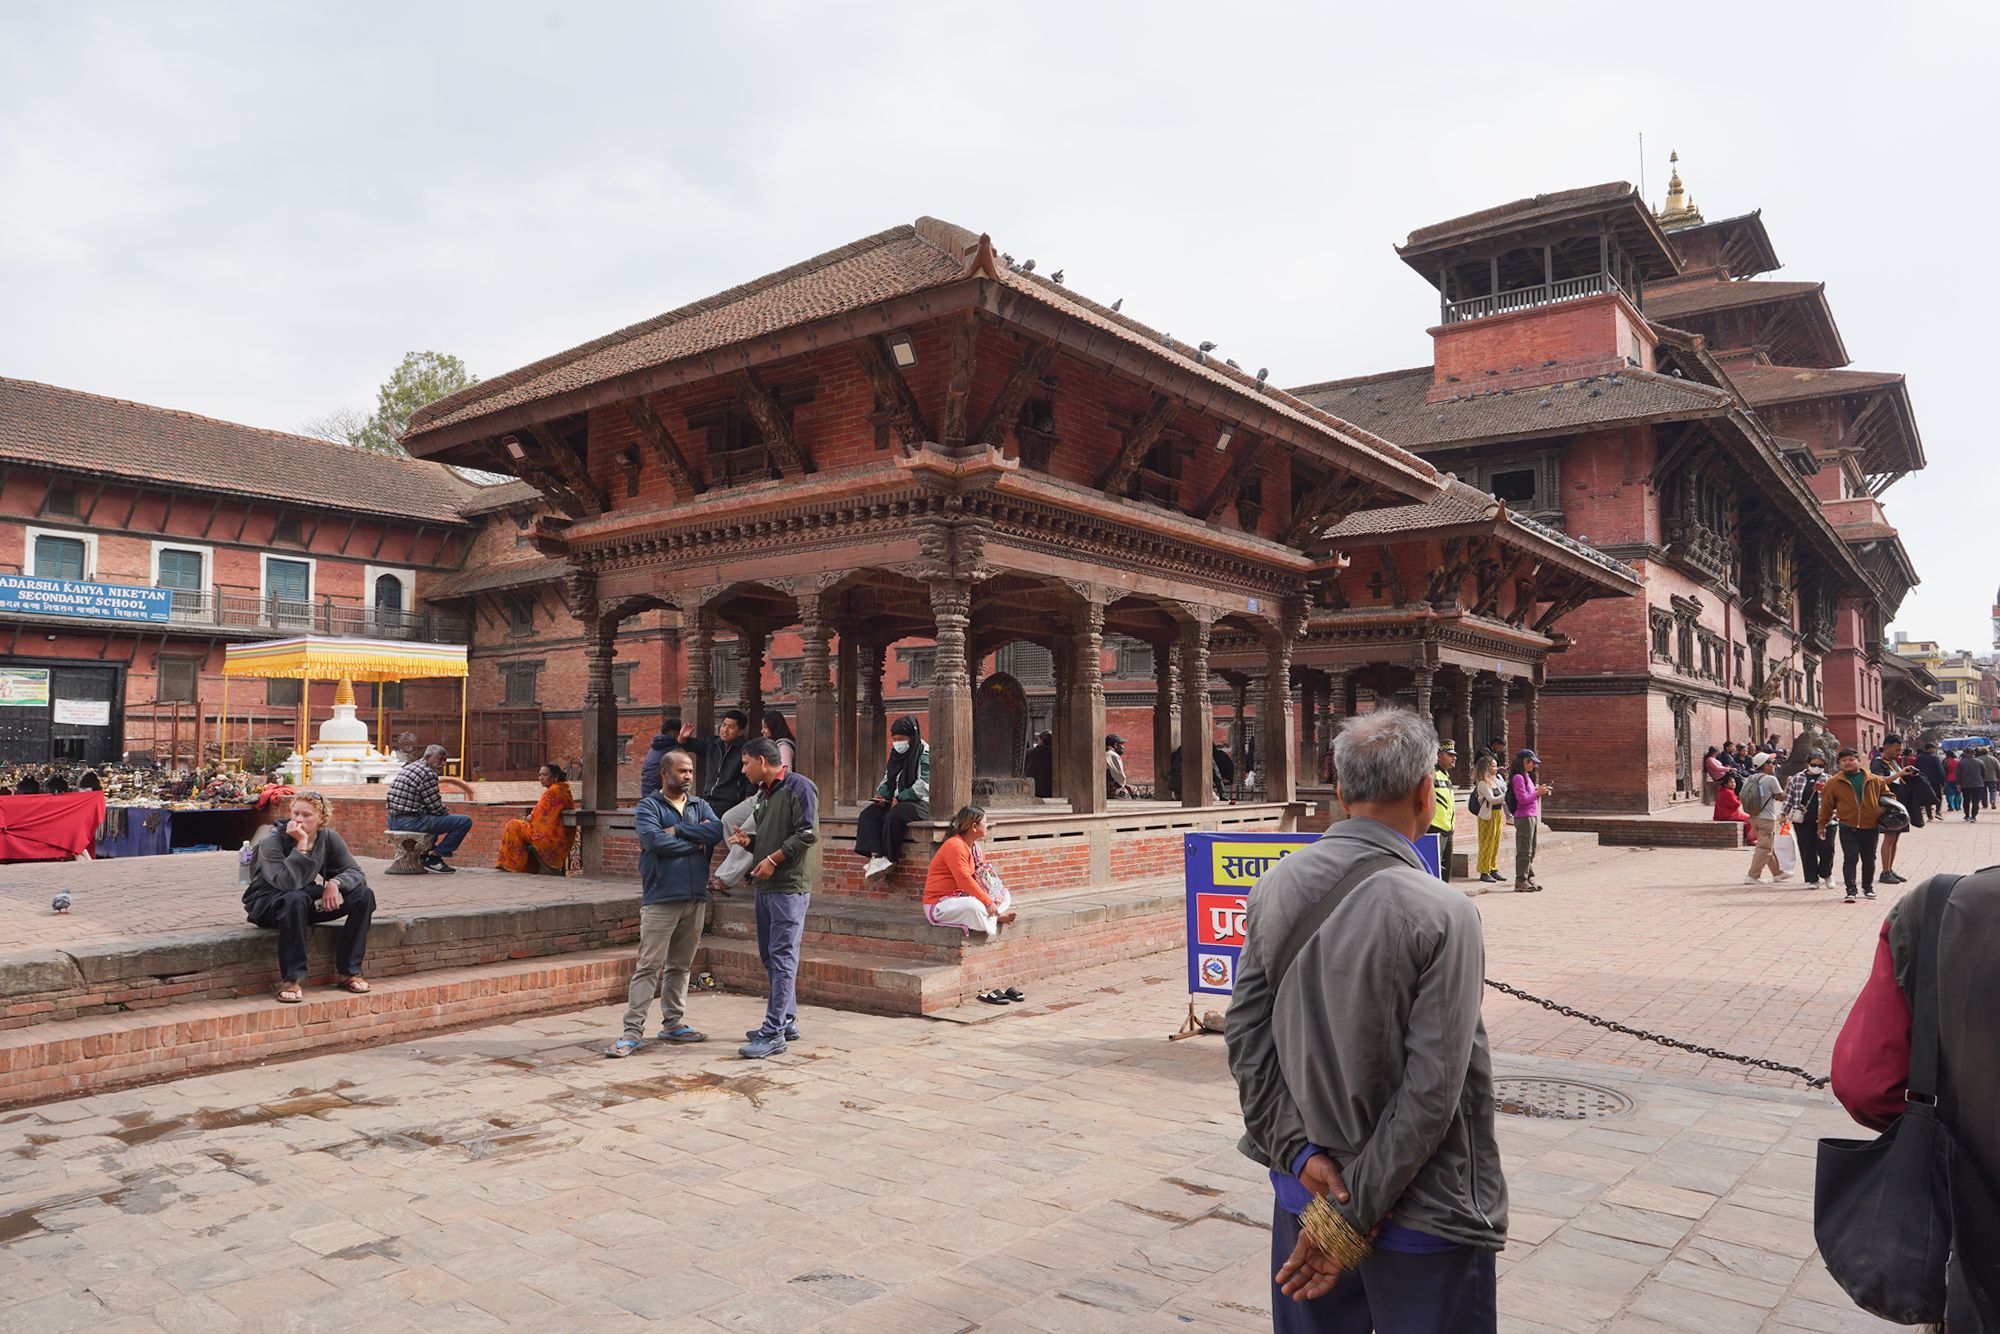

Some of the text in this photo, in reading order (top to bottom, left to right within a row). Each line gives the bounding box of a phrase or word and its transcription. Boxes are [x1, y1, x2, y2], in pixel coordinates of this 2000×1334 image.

[0, 577, 166, 600] ADARSHA KANYA NIKETAN
[18, 590, 146, 610] SECONDARY SCHOOL
